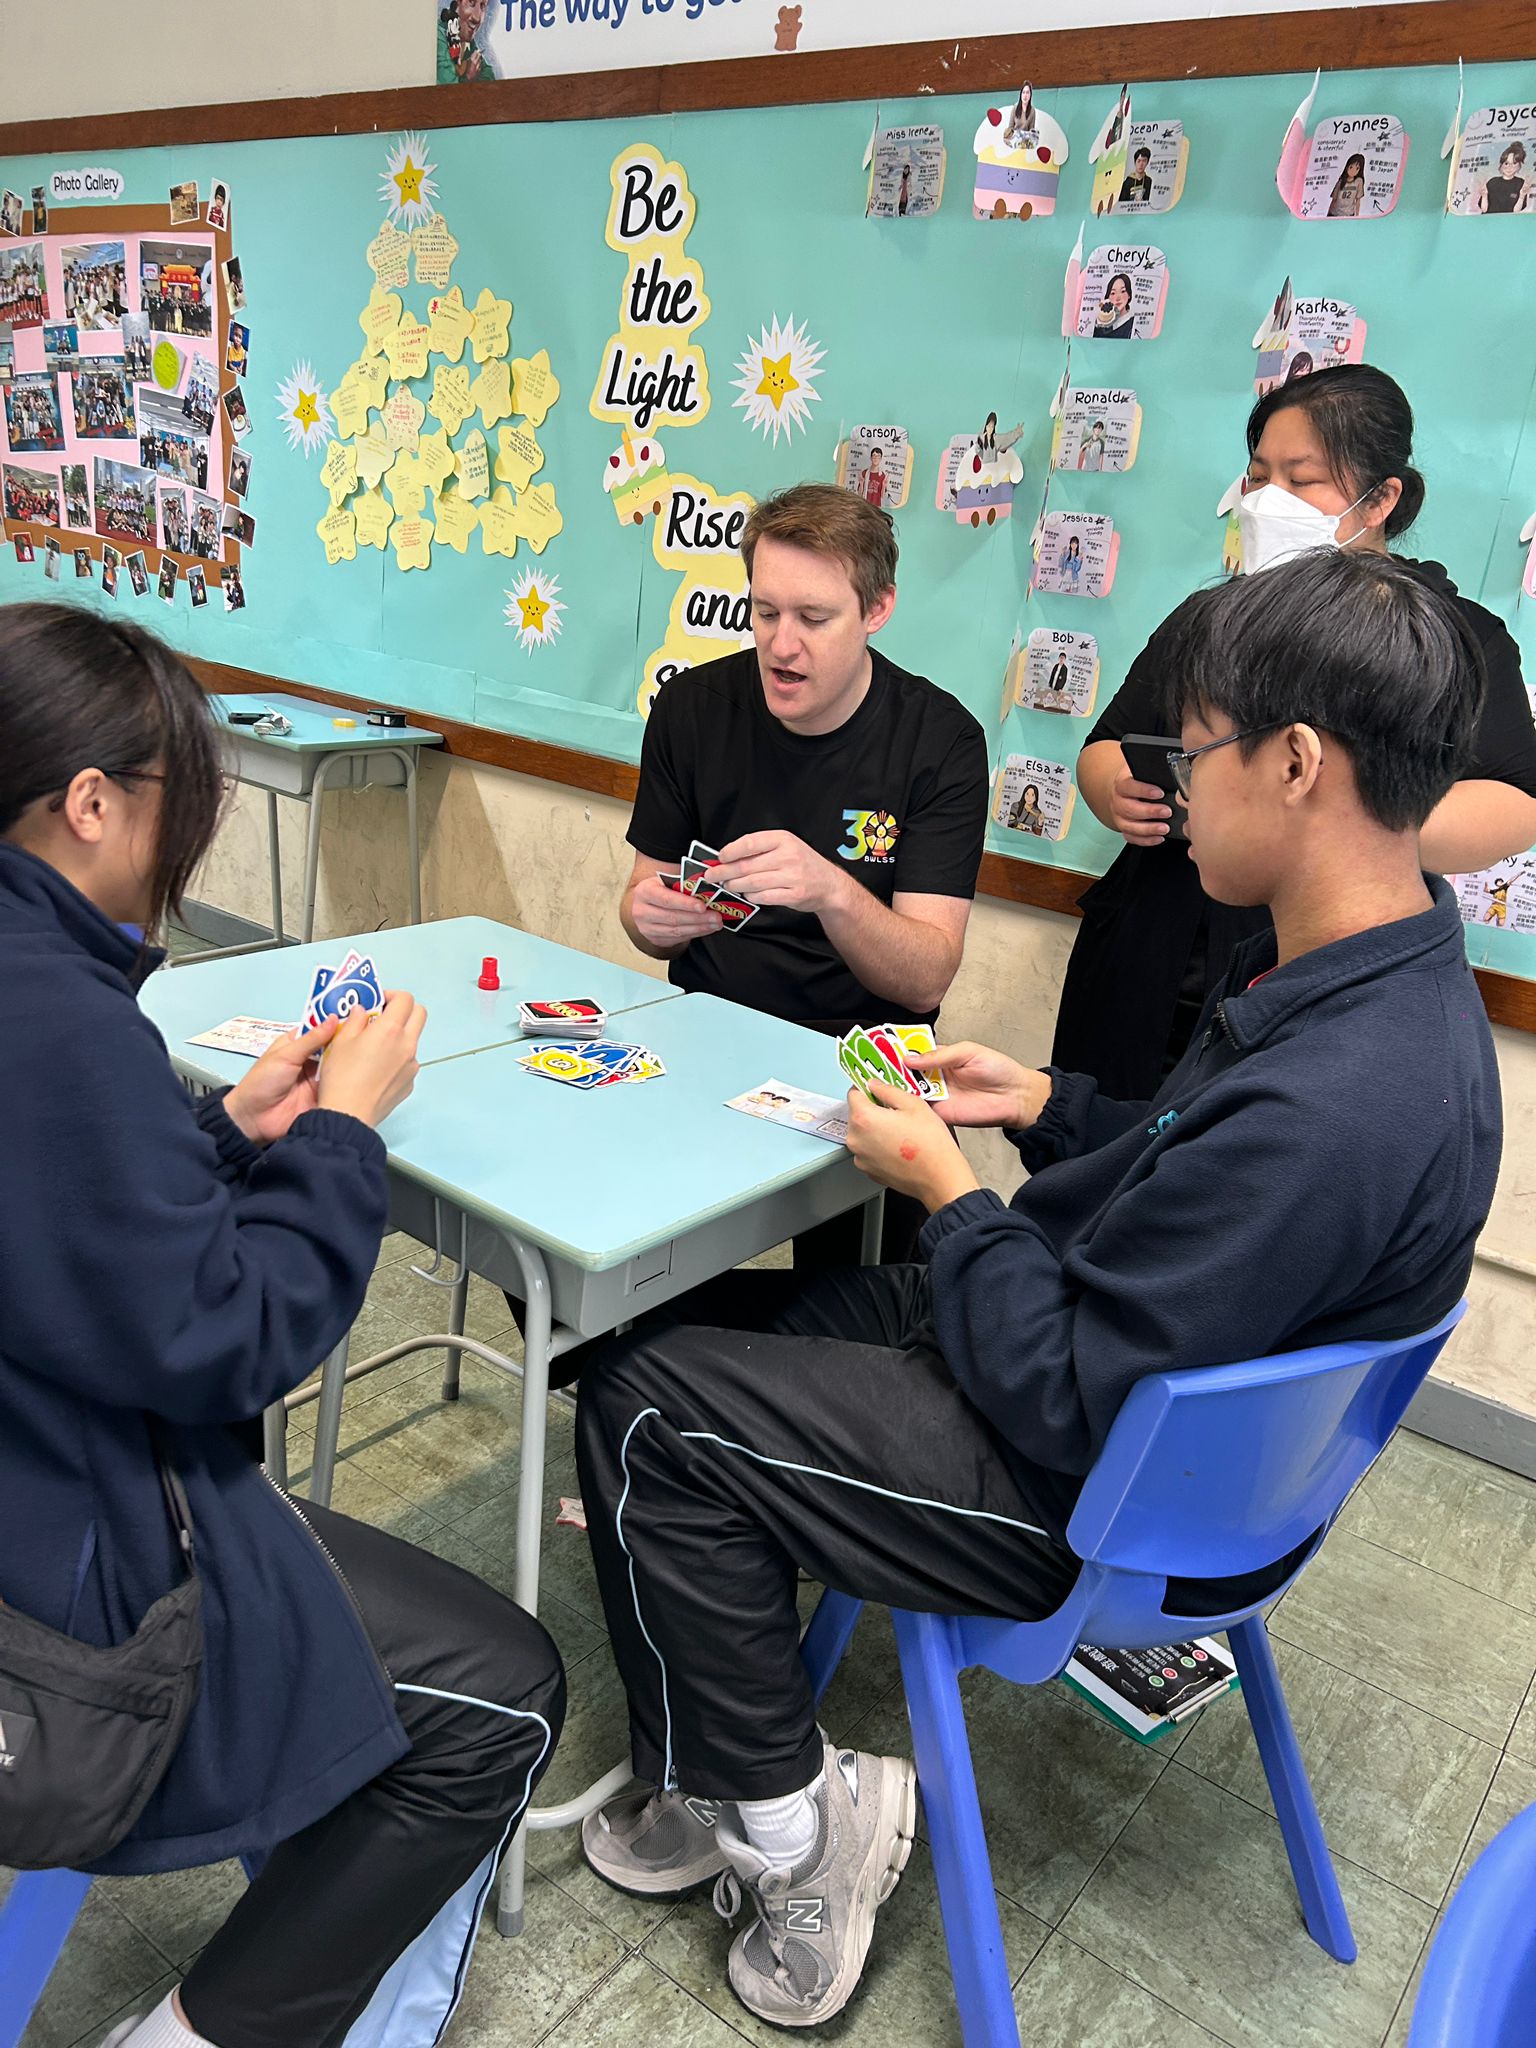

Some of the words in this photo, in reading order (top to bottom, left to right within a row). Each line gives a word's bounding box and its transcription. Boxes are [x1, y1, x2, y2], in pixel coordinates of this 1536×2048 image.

[500, 0, 556, 32] The
[565, 0, 629, 29] way
[886, 130, 906, 140] Miss
[909, 127, 929, 137] Irene
[1333, 117, 1389, 135] Yannes
[54, 176, 81, 192] Photo
[84, 174, 119, 193] Gallery
[620, 164, 683, 237] Be
[1107, 247, 1150, 268] Cheryl
[630, 257, 697, 324] the
[1295, 298, 1338, 315] Karka
[605, 350, 697, 429] Light
[1075, 390, 1121, 404] Ronald
[860, 427, 897, 438] Carson
[666, 491, 745, 550] Rise
[1062, 513, 1094, 523] Jessica
[1052, 632, 1074, 643] Bob
[1026, 760, 1051, 774] Elsa
[337, 988, 360, 1017] 8
[547, 1001, 583, 1018] UNO
[784, 1898, 825, 1934] N
